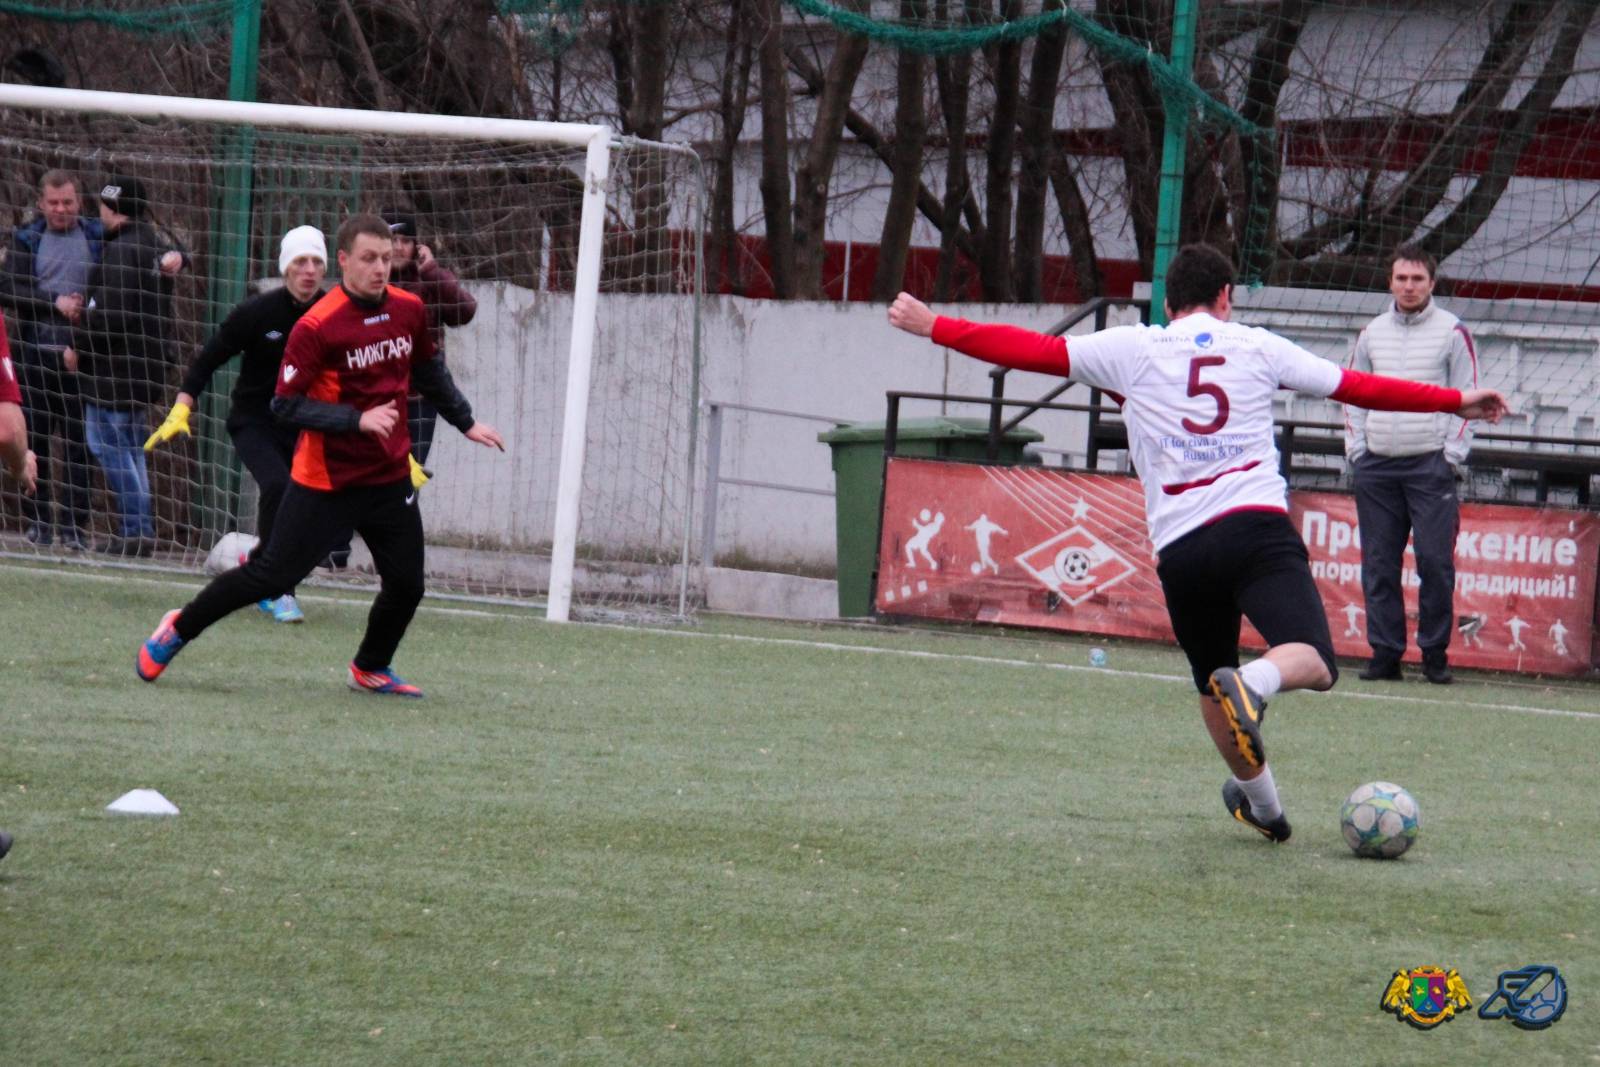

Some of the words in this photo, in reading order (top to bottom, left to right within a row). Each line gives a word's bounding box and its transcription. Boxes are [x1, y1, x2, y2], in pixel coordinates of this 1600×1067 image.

[346, 333, 413, 369] НИЖГАРЫ
[1181, 355, 1230, 435] 5
[1184, 448, 1216, 462] Russia
[1218, 445, 1226, 458] &
